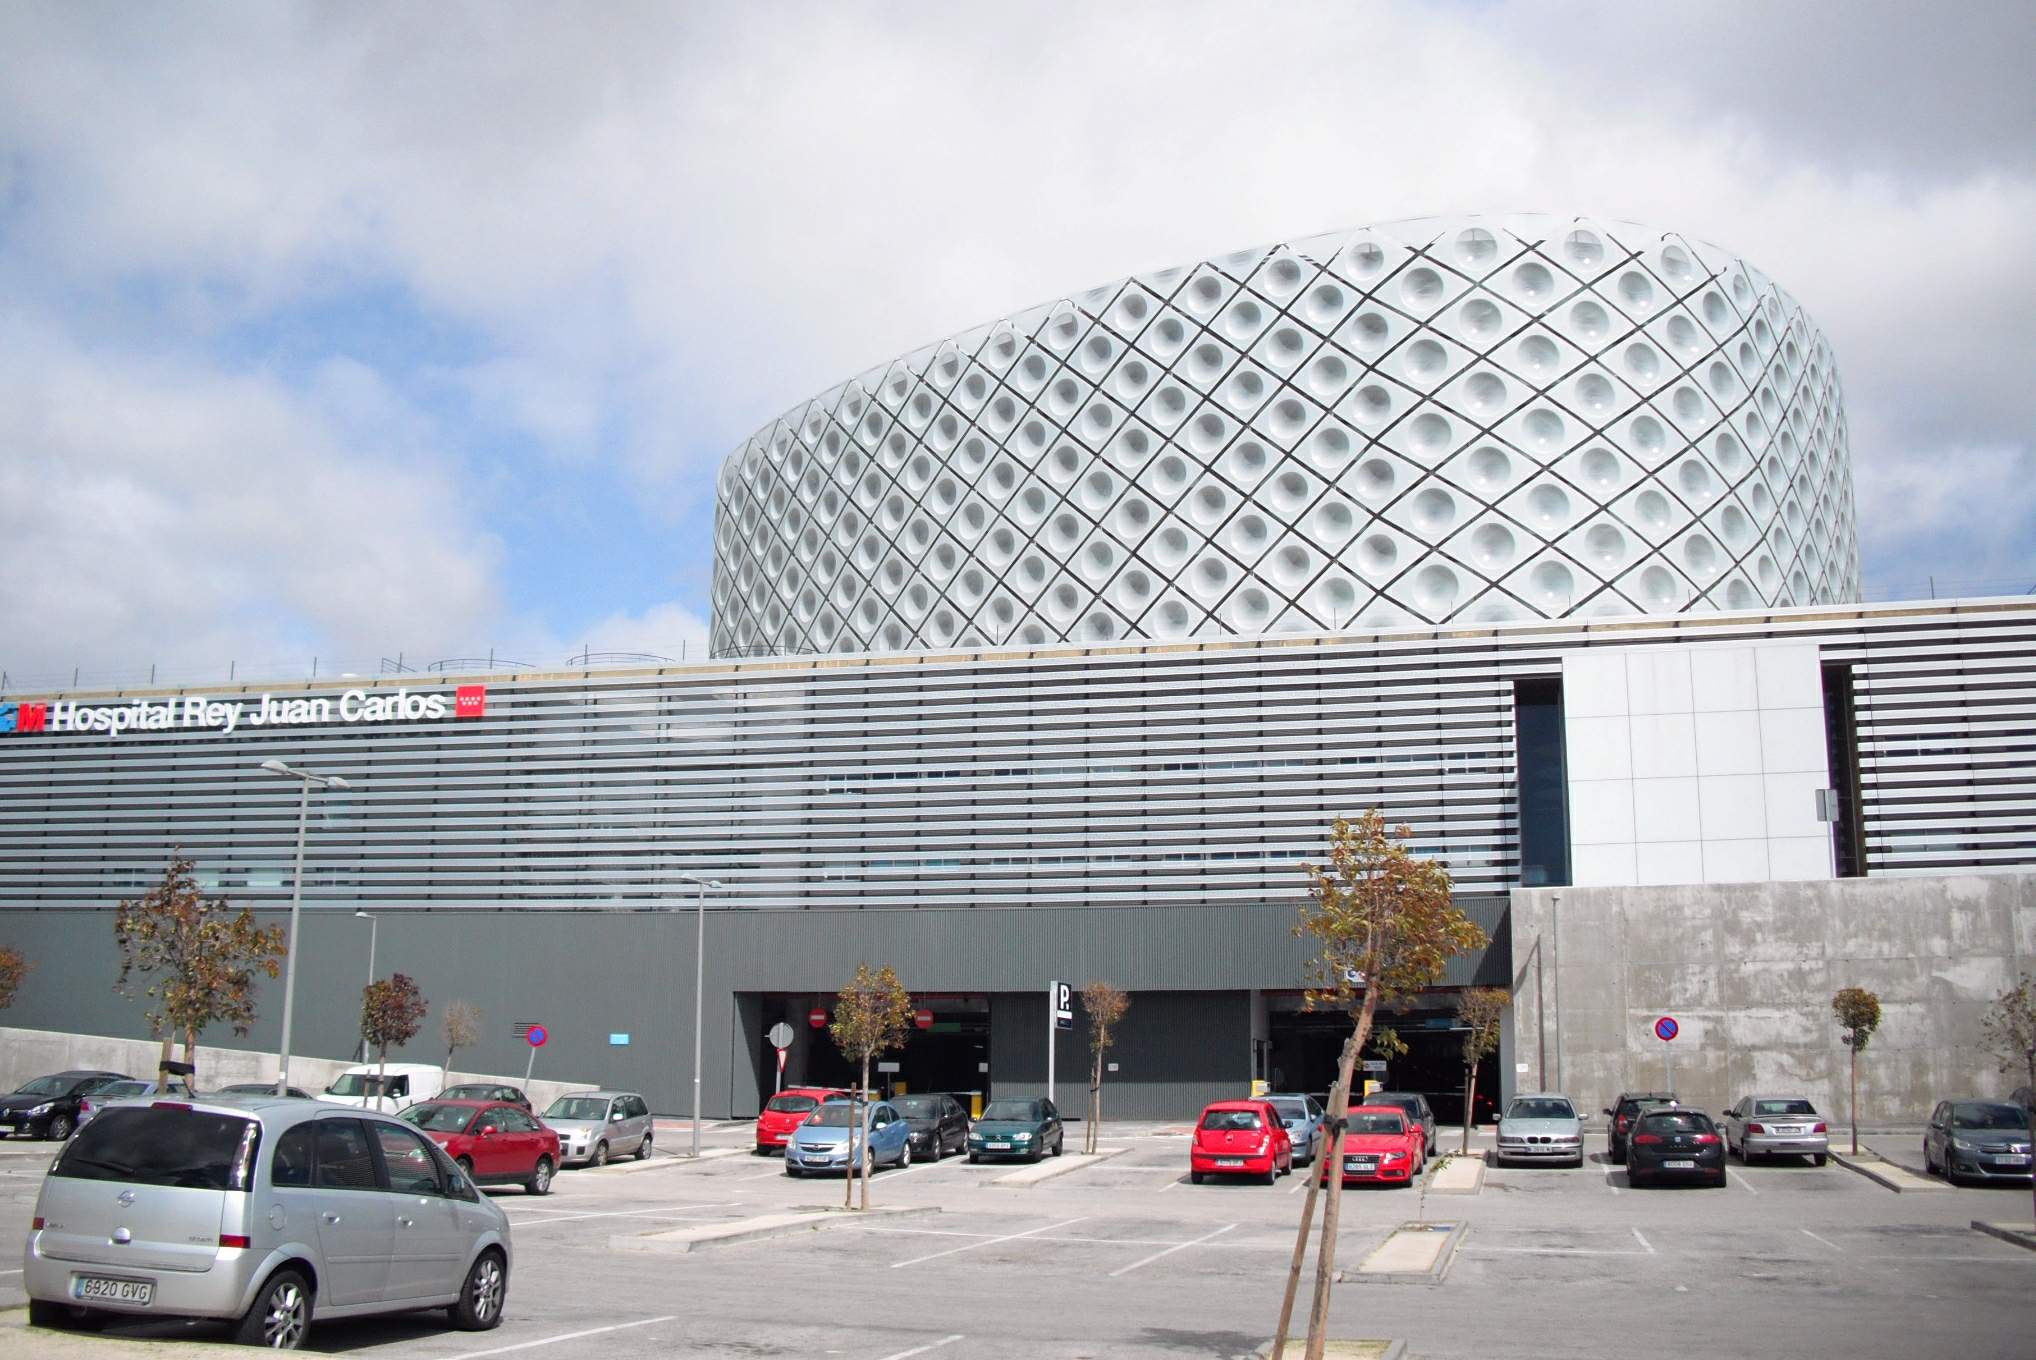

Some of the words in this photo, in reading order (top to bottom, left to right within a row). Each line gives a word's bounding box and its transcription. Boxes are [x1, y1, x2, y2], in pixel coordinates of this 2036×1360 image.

[52, 698, 176, 737] Hospital
[183, 697, 243, 734] Rey
[250, 694, 330, 725] Juan
[340, 688, 446, 722] Carlos
[85, 1280, 117, 1296] 6920
[122, 1284, 147, 1299] GVG
